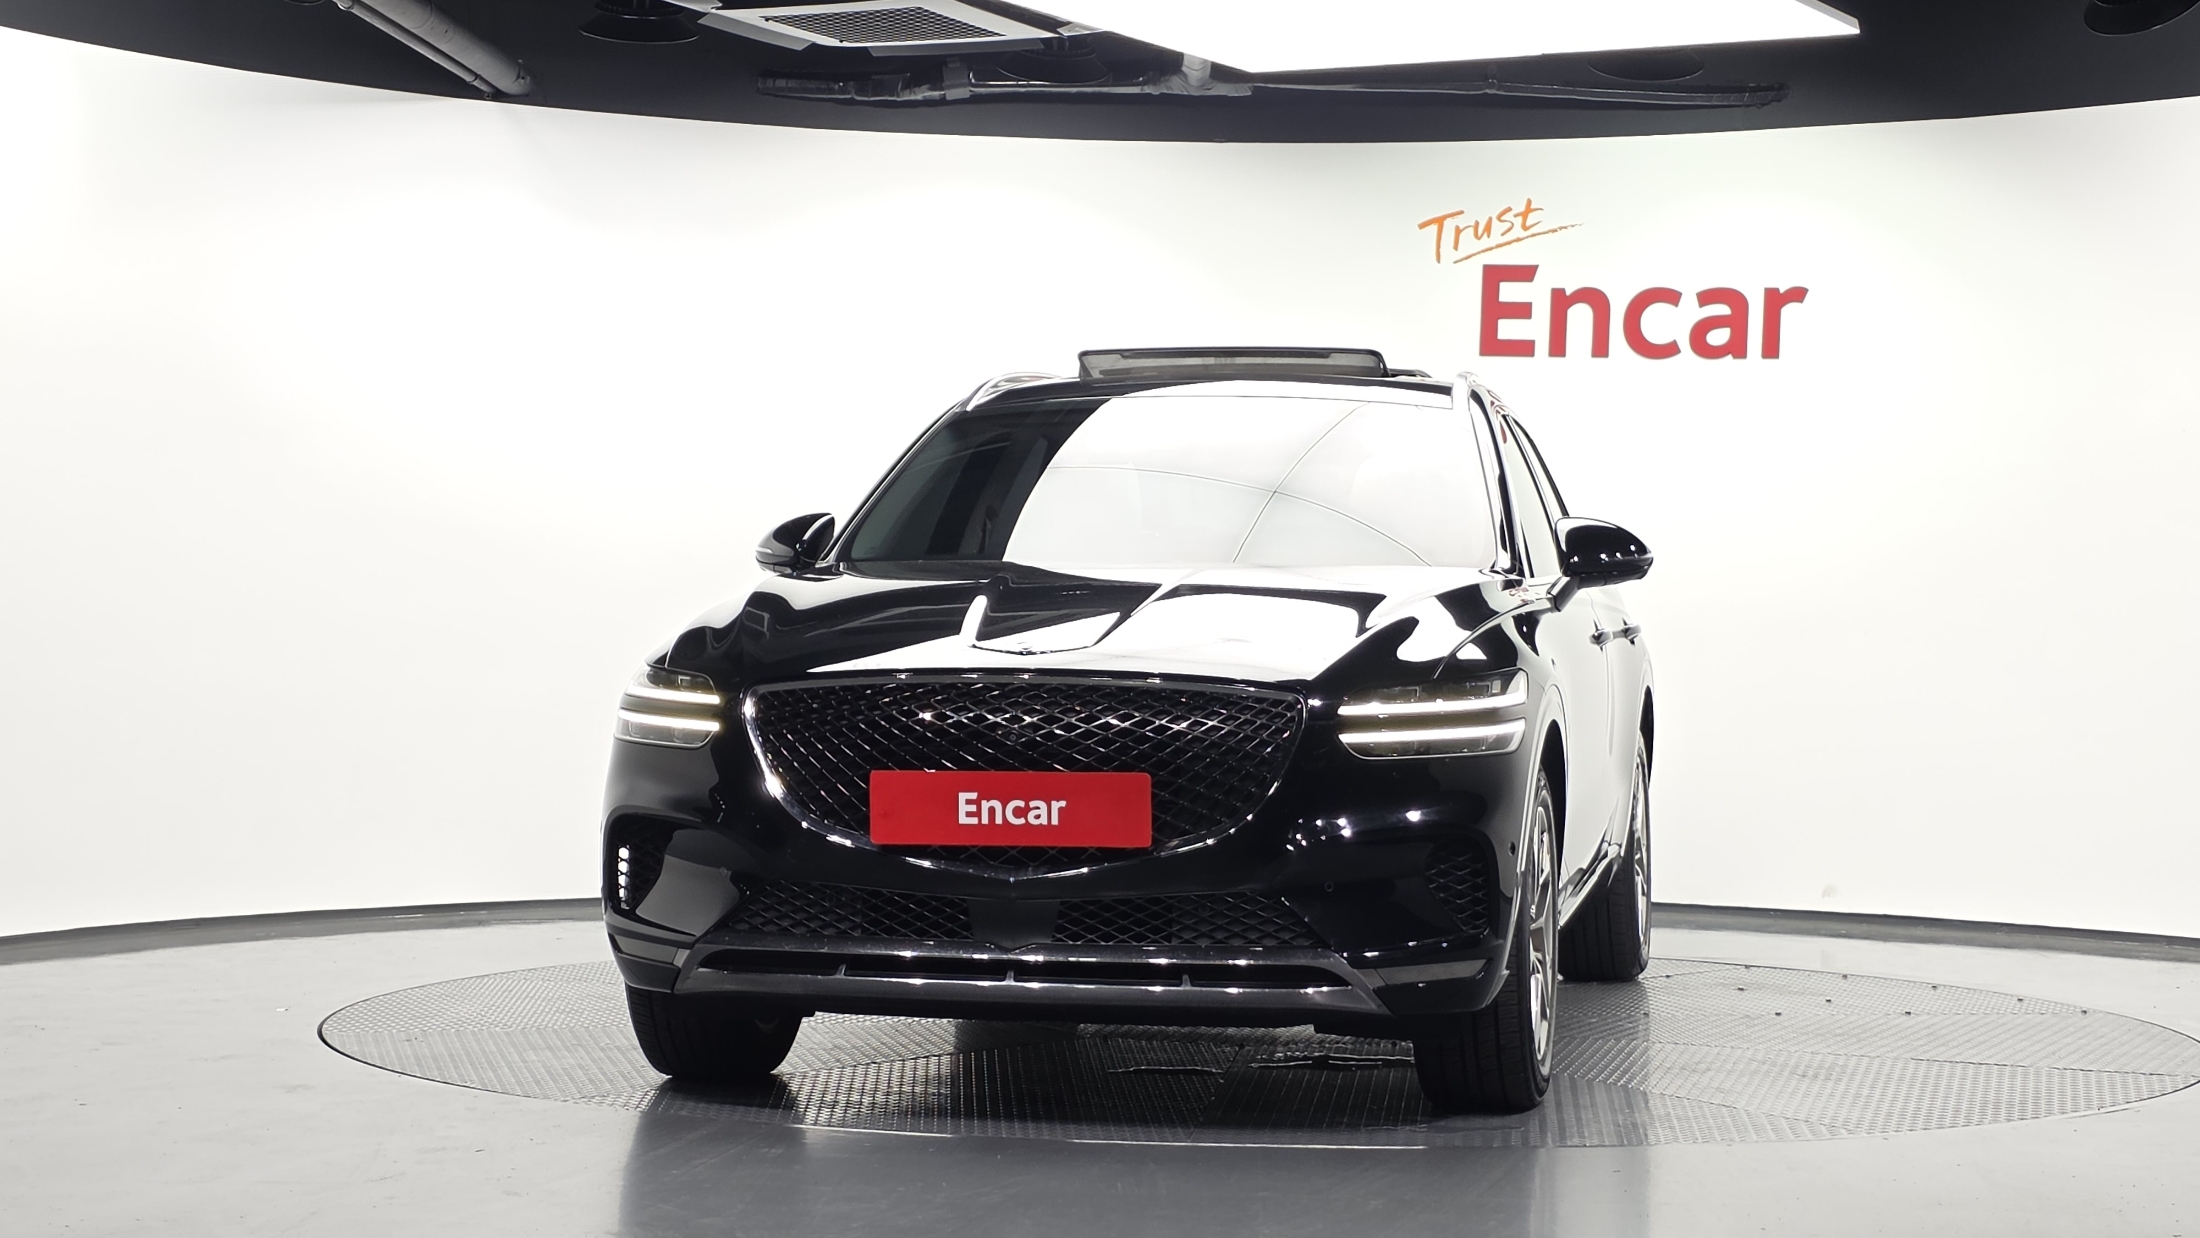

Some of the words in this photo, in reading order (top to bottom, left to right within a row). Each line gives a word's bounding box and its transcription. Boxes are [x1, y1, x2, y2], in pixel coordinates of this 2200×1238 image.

[1417, 197, 1545, 264] Trust
[1479, 264, 1809, 360] Encar
[957, 791, 1067, 826] Encar
